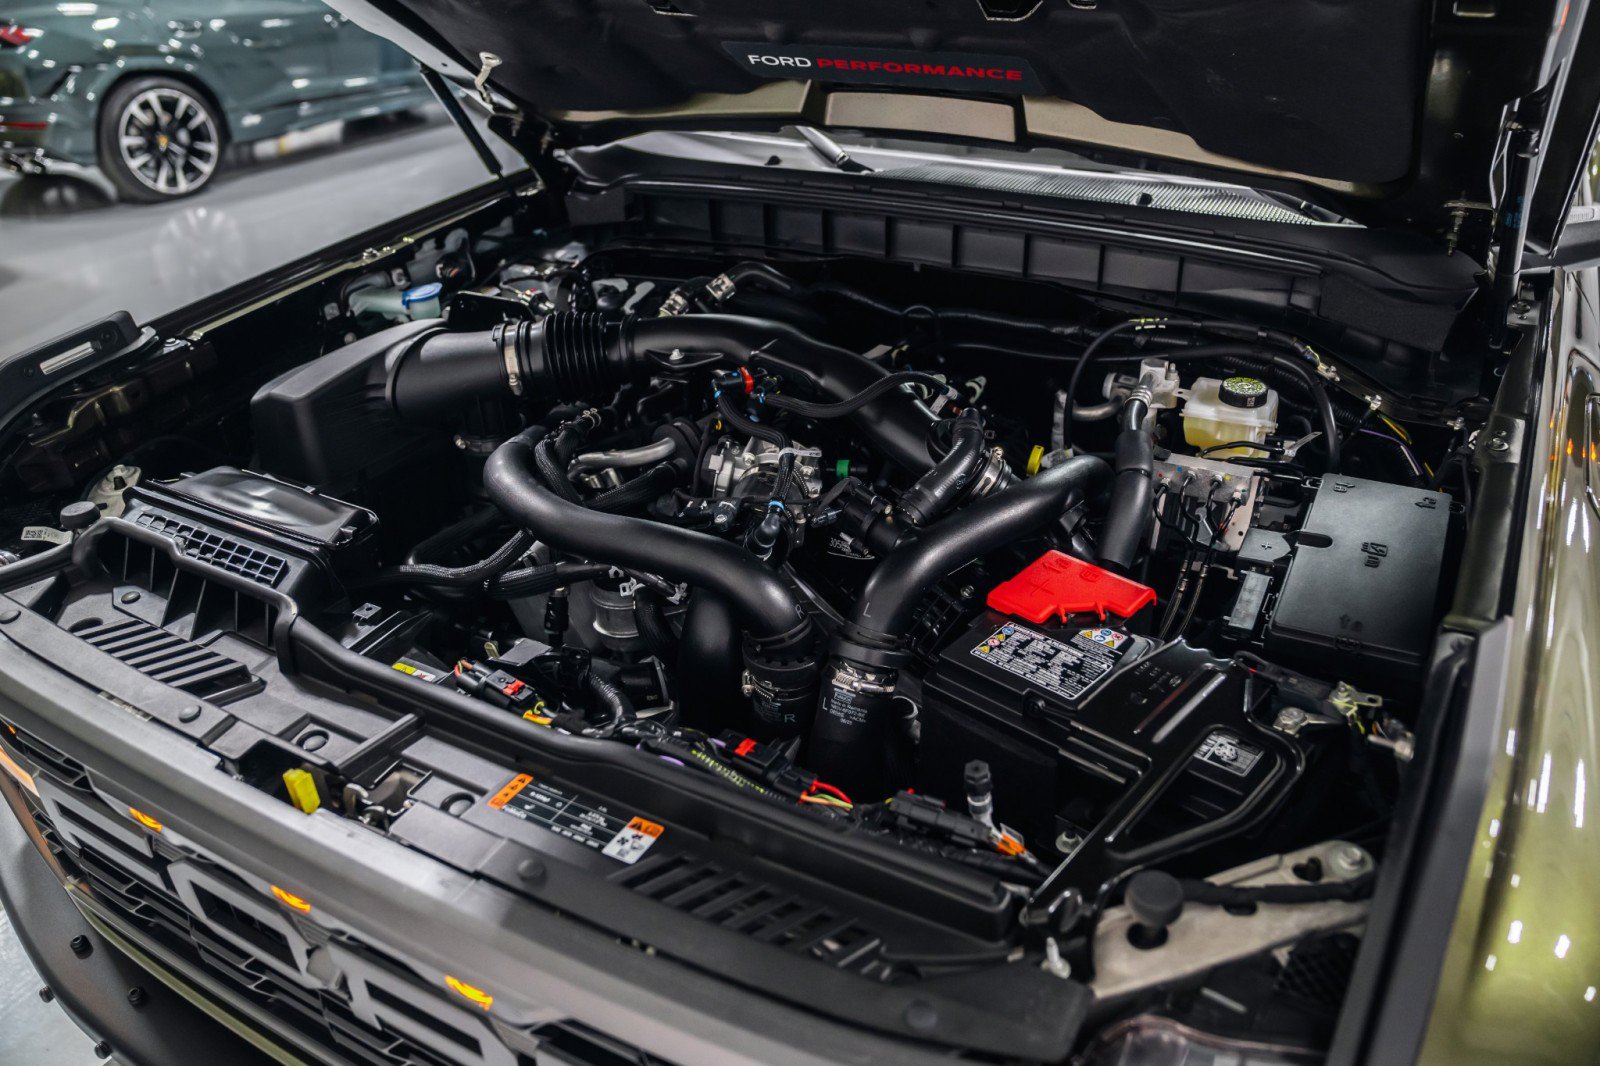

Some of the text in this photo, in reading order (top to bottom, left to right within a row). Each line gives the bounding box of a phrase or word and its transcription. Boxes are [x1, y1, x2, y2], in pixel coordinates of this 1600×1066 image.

[748, 54, 1023, 81] FORD PERFORMANCE
[863, 602, 872, 618] L
[822, 697, 828, 710] L
[784, 713, 796, 723] R
